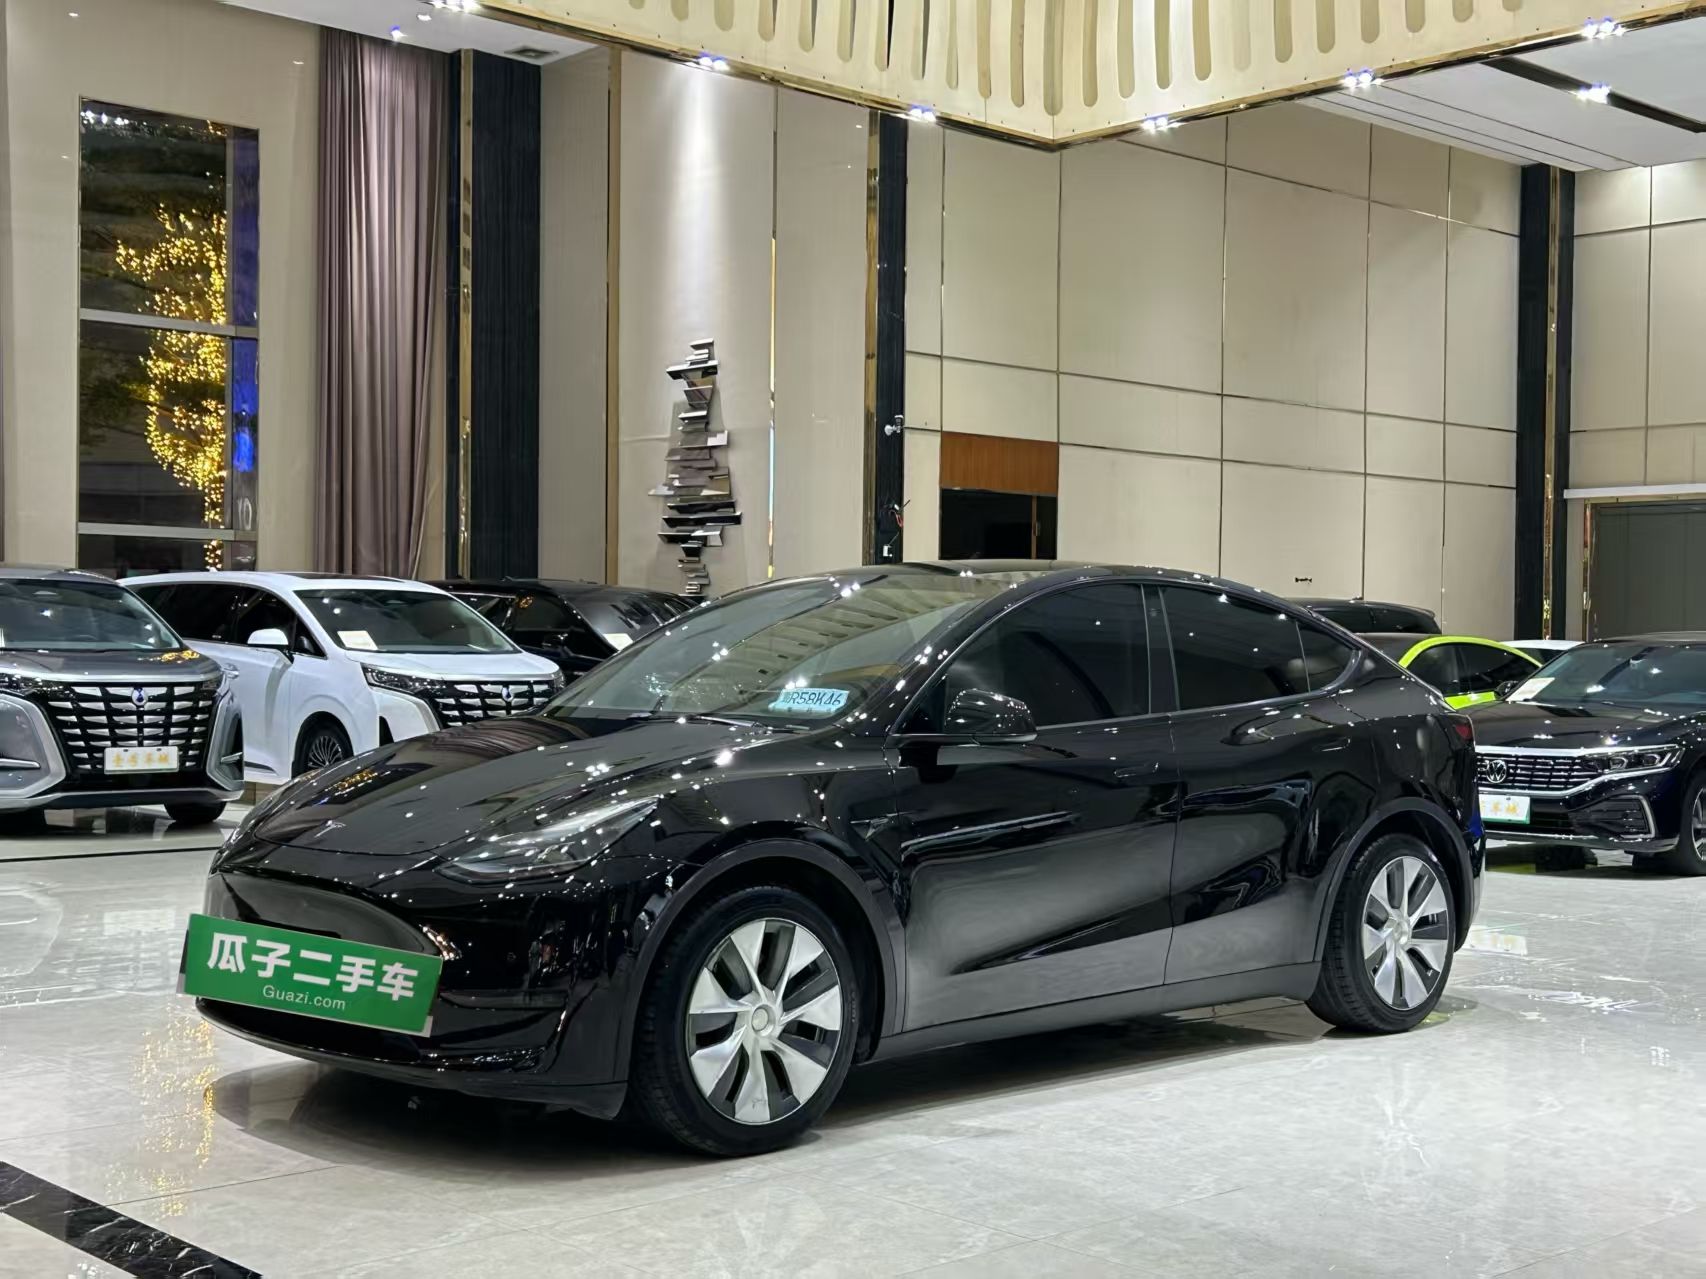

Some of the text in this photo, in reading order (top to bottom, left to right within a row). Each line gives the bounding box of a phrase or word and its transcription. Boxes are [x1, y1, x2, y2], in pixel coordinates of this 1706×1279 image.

[207, 932, 419, 1001] 瓜子二手车
[262, 984, 346, 1010] Guazi.com
